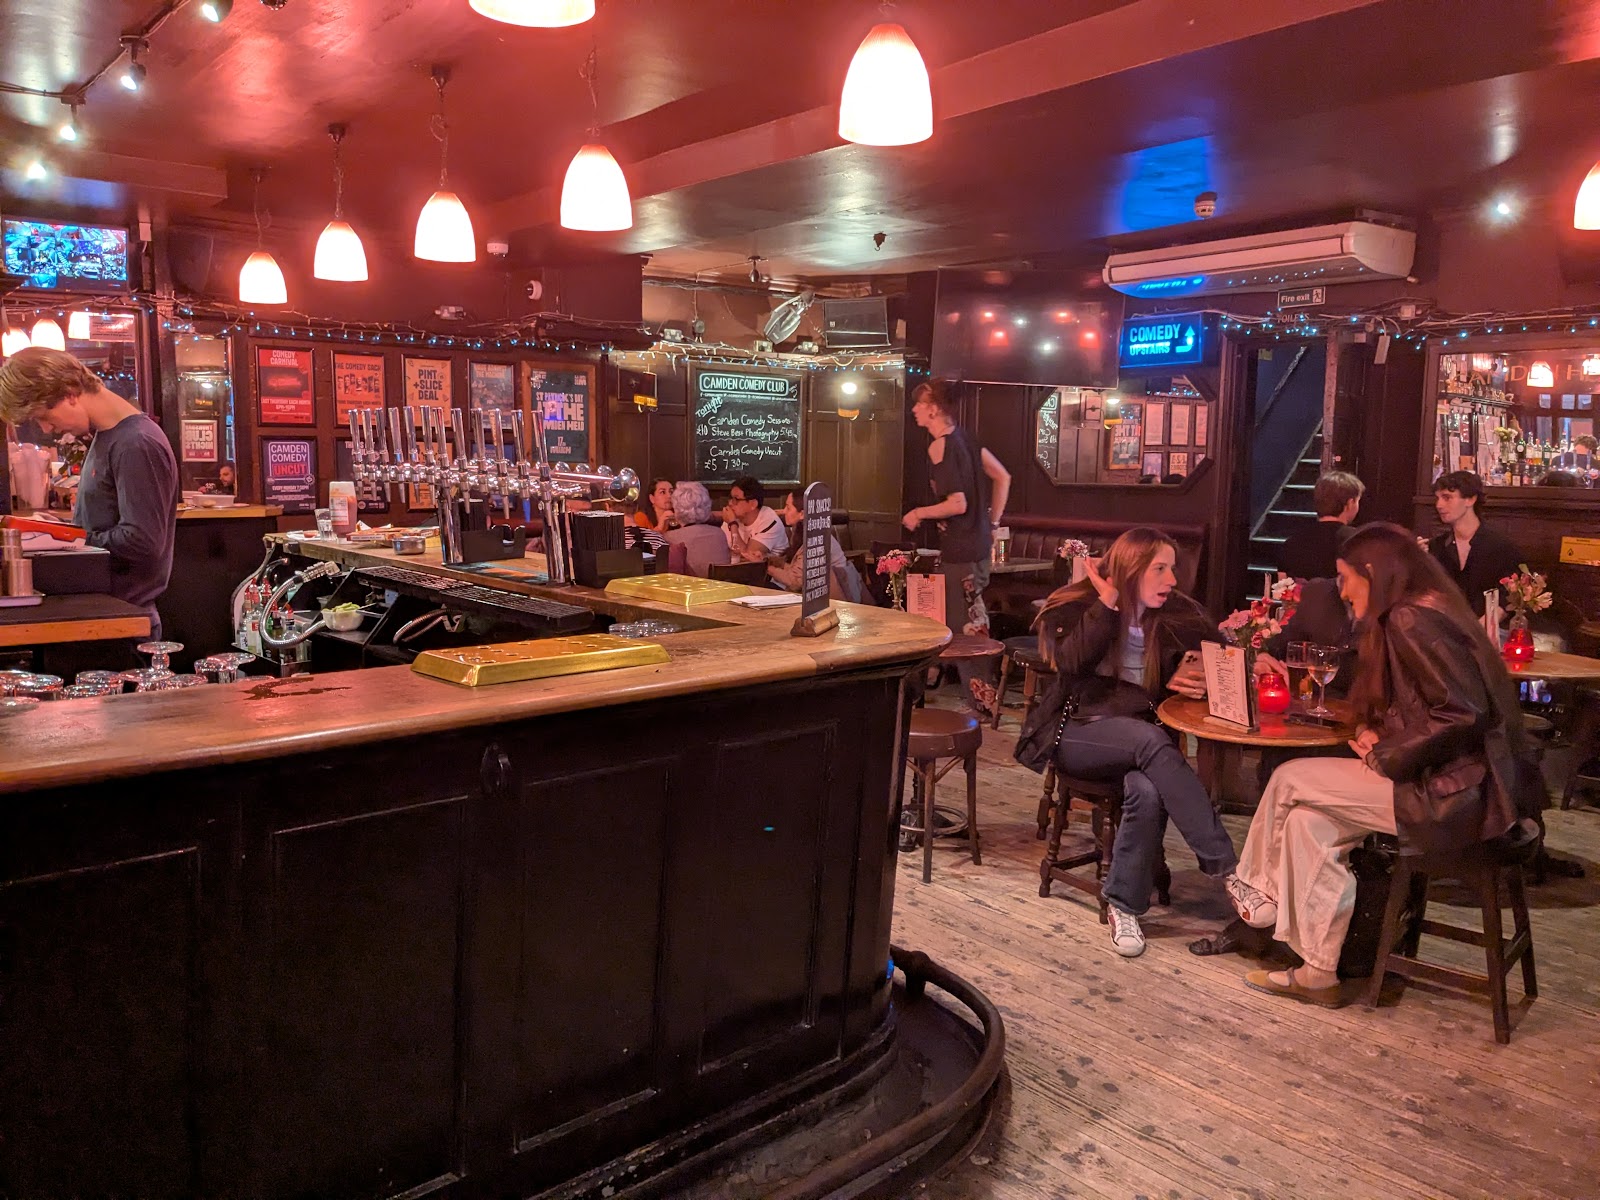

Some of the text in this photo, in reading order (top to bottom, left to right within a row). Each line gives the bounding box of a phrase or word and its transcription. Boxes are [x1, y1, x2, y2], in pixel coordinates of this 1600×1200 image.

[1281, 293, 1310, 303] Fire exit
[1277, 313, 1310, 323] TOILES
[1129, 323, 1181, 343] COMEDY
[272, 350, 296, 358] COMEDY
[1129, 341, 1171, 356] UPSTAIRS
[270, 357, 299, 366] CARNIVAL
[345, 362, 366, 370] COMEDY
[418, 369, 437, 379] PINT
[702, 376, 738, 390] CAMDEN
[739, 379, 766, 391] COMEDY
[767, 381, 785, 392] CLUB
[418, 390, 439, 400] DEAL
[695, 396, 723, 418] Tonight
[708, 412, 739, 426] Camden
[741, 414, 765, 430] Comedy
[697, 424, 708, 436] £10
[711, 427, 729, 437] Steve
[731, 429, 743, 437] Best
[745, 428, 779, 441] Photography
[270, 444, 307, 453] CAMDEN
[710, 445, 782, 460] Camden Comedy Uncut
[271, 453, 307, 462] COMEDY
[273, 463, 306, 475] UNCUT
[704, 459, 717, 471] £5
